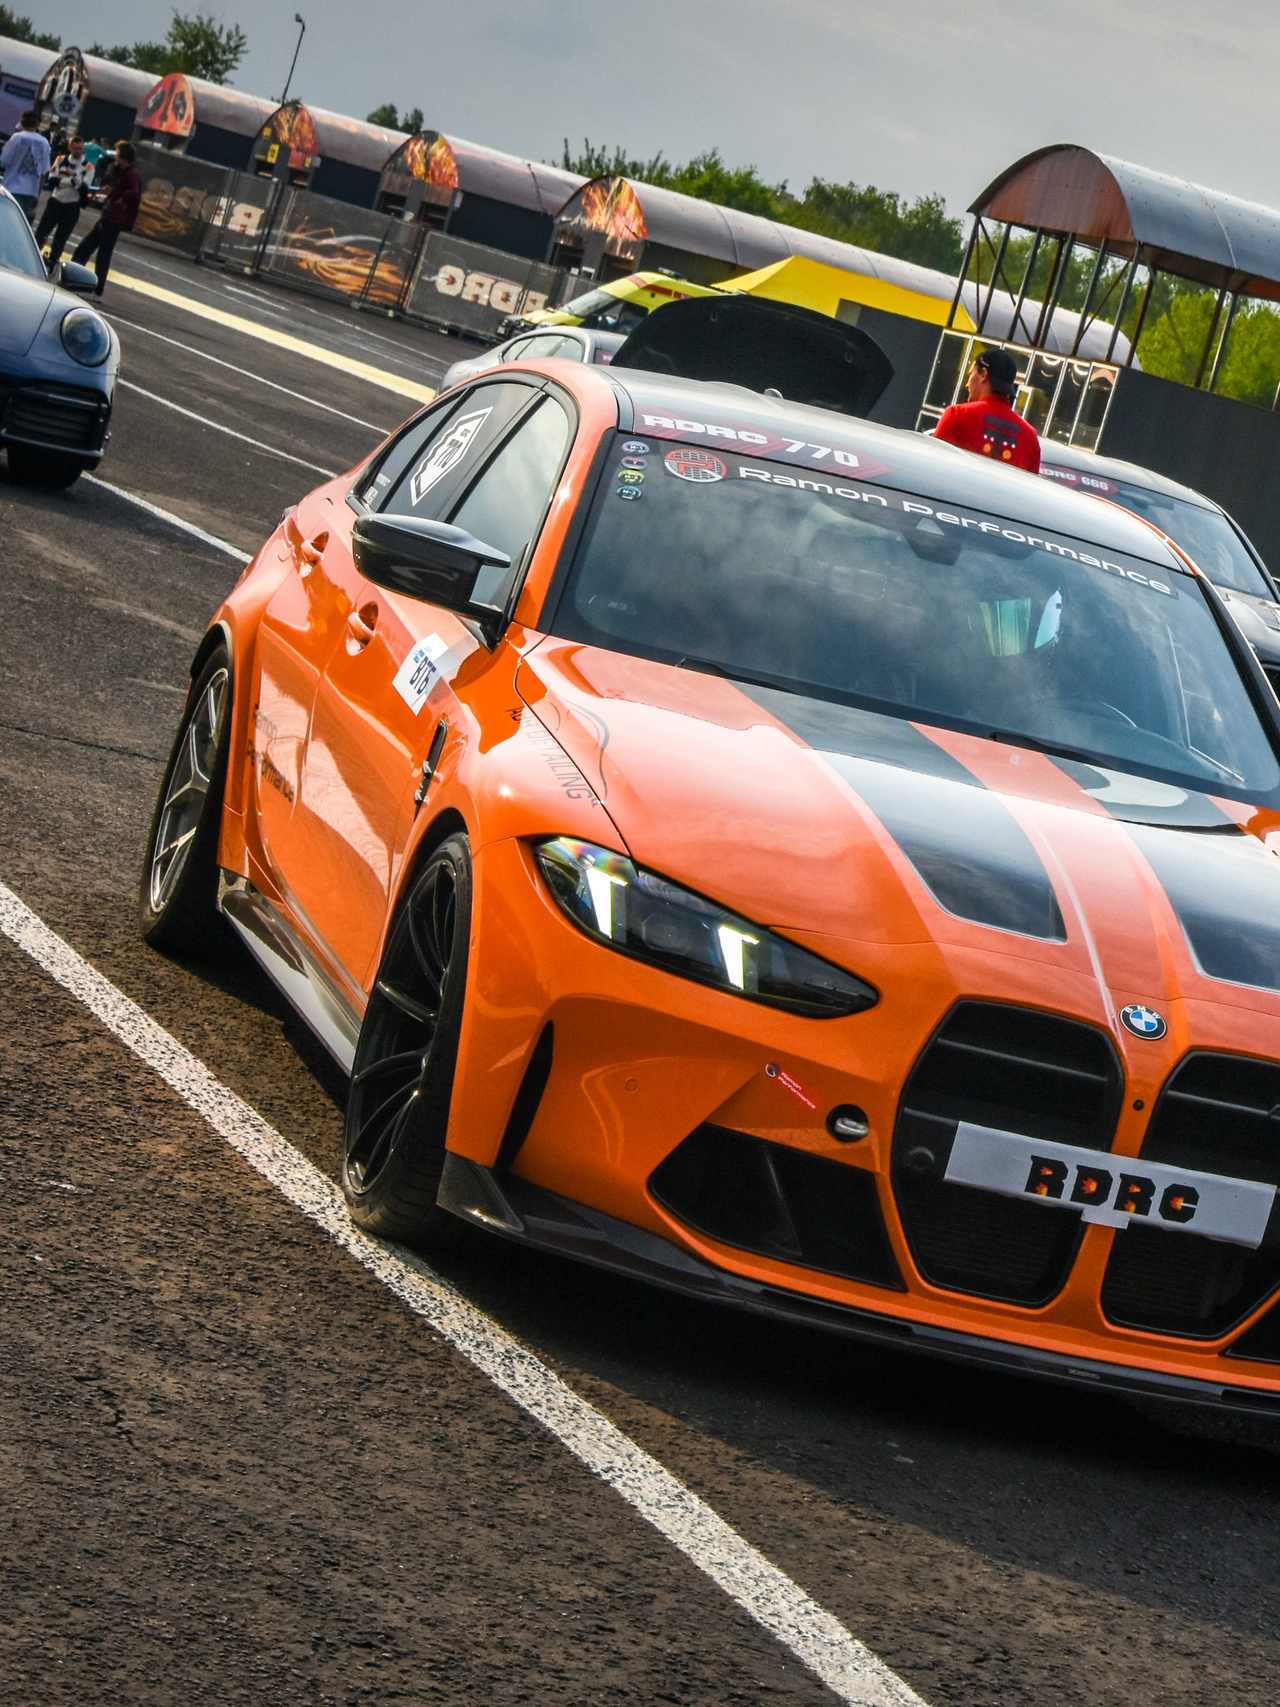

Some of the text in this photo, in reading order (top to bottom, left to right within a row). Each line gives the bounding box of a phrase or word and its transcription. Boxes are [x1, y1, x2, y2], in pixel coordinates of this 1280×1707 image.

[432, 438, 463, 469] 770
[641, 414, 860, 468] RDRC 770
[738, 466, 1171, 596] Ramon Performance
[1024, 1155, 1200, 1223] RDRC
